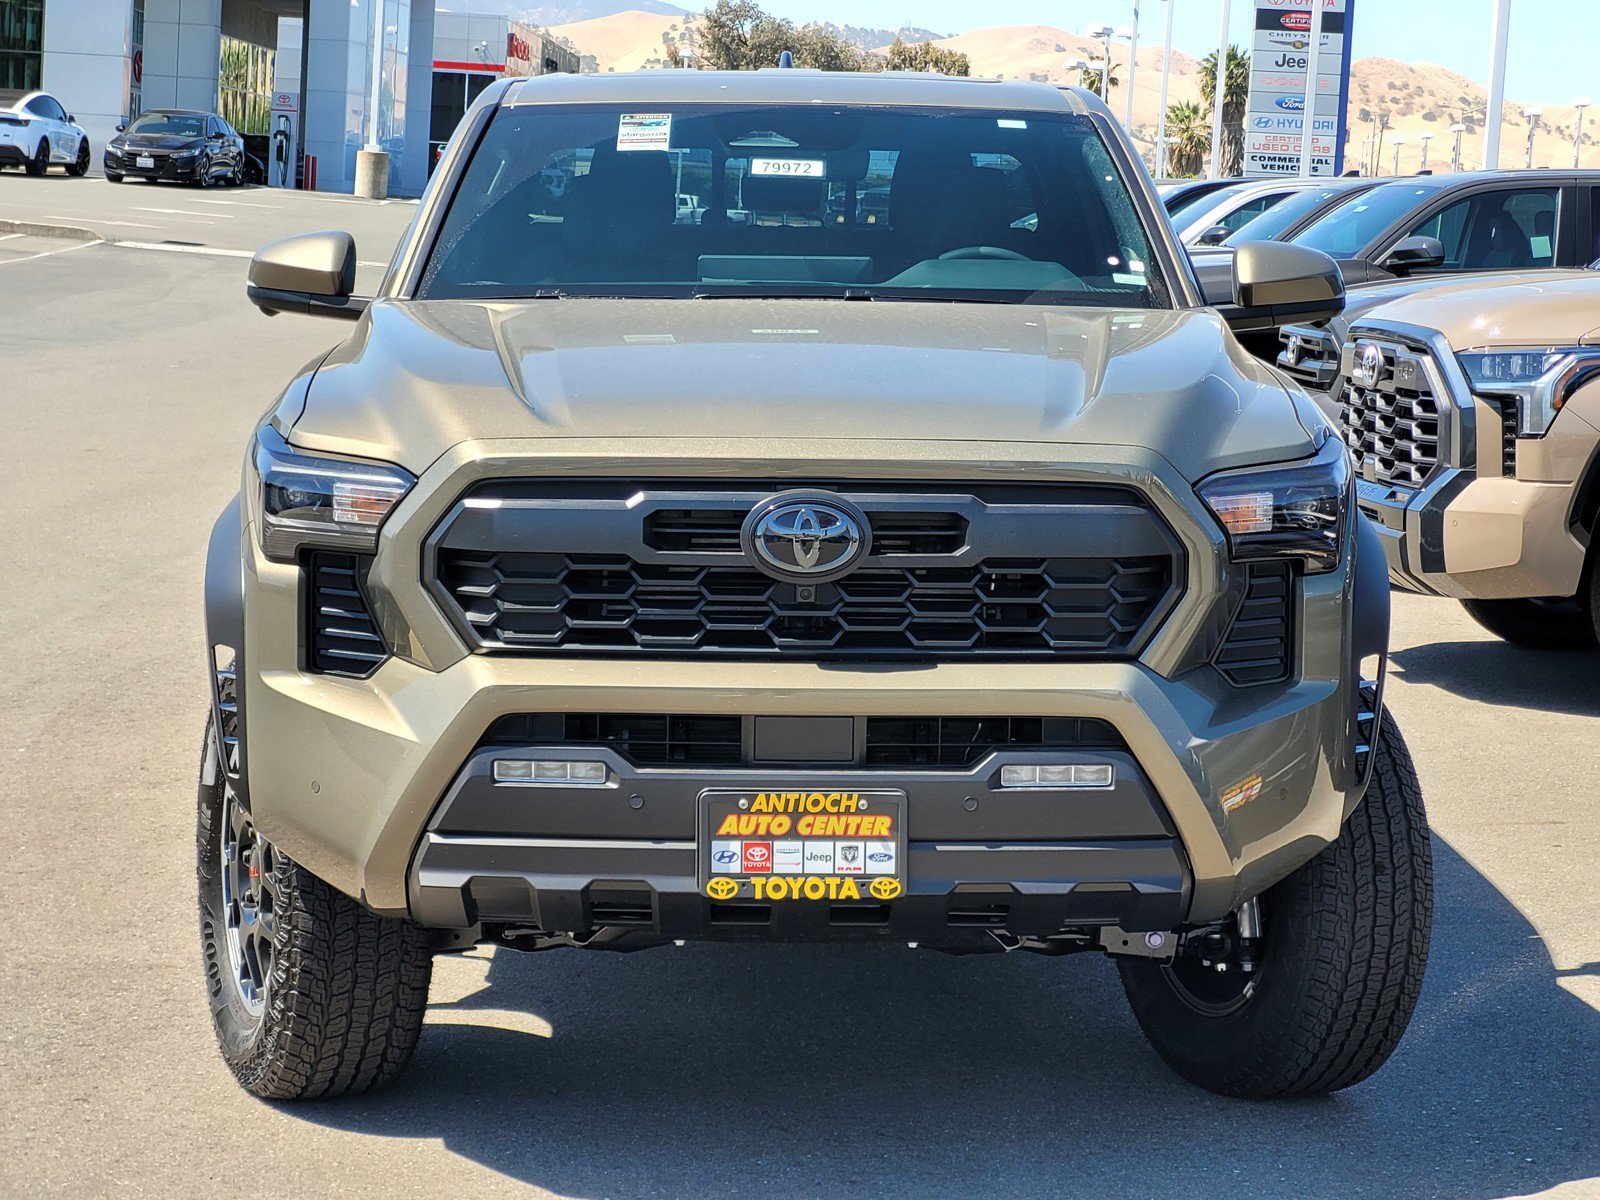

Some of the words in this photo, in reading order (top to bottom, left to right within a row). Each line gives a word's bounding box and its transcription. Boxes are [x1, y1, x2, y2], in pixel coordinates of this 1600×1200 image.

[1280, 17, 1312, 25] CERTIFI
[1268, 32, 1330, 40] CHRYSR
[1274, 53, 1309, 69] Jee
[1261, 77, 1331, 89] DODE
[1276, 118, 1334, 131] HYUDAI
[1264, 135, 1320, 144] CERTIFD
[1252, 143, 1290, 152] USED
[1293, 145, 1331, 154] CRS
[1250, 155, 1331, 166] COMMERIAL
[761, 161, 812, 174] 79972
[1260, 163, 1319, 173] VEHICS
[750, 792, 859, 813] ANTIOCH
[716, 814, 793, 836] AUTO
[796, 814, 893, 837] CENTER
[805, 852, 832, 863] Jeep
[750, 876, 861, 900] TOYOTA
